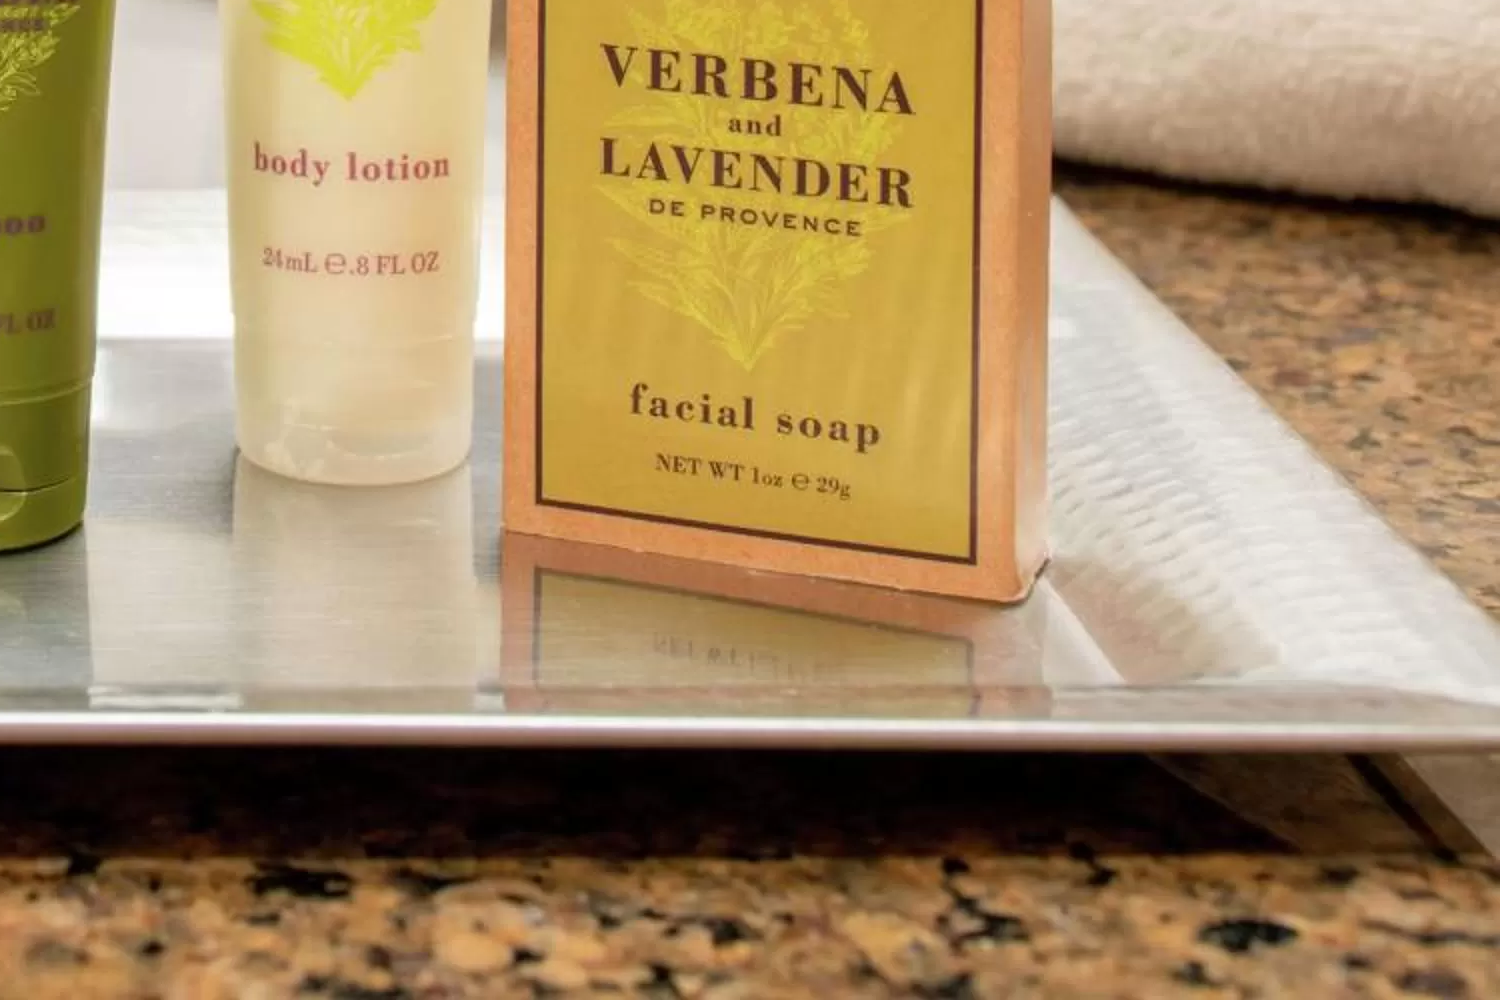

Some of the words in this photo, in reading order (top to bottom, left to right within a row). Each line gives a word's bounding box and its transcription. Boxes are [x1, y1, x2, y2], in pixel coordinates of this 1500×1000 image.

[600, 43, 916, 115] VERBENA
[728, 115, 782, 137] and
[253, 141, 331, 187] body
[345, 151, 450, 181] lotion
[600, 137, 915, 208] LAVENDER
[649, 199, 685, 217] DE
[701, 204, 862, 237] PROVENCE
[262, 247, 318, 273] 24mL
[376, 254, 406, 275] FL
[411, 250, 441, 274] OZ
[630, 382, 754, 430] facial
[776, 410, 880, 453] soap
[655, 453, 702, 475] NET
[708, 461, 745, 482] WT
[752, 467, 783, 488] 1oz
[816, 476, 851, 501] 29g
